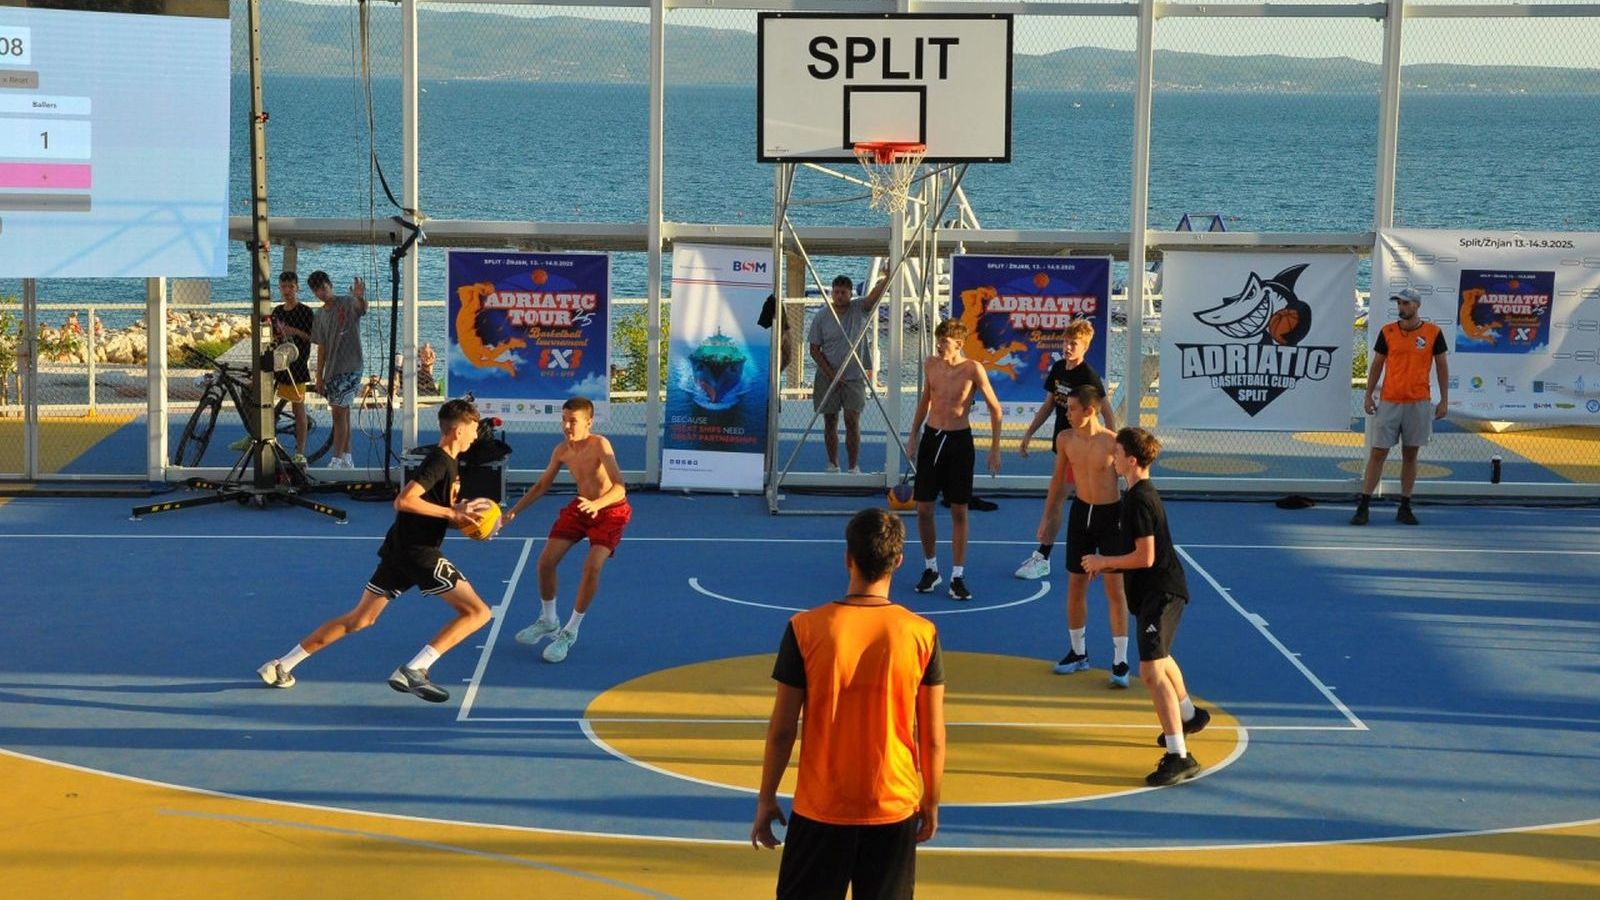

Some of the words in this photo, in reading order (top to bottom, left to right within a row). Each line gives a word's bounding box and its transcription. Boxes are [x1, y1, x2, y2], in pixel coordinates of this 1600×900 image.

[807, 36, 960, 80] SPLIT
[32, 101, 58, 109] Ballers
[39, 131, 49, 149] 1
[1459, 237, 1513, 249] Split/Žnjan
[1514, 238, 1576, 249] 13.-14.9.2025.
[484, 292, 596, 309] ADRIATIC
[987, 296, 1097, 313] ADRIATIC
[1478, 294, 1549, 305] ADRIATIC
[1492, 305, 1532, 314] TOUR
[509, 310, 572, 325] TOUR
[572, 308, 597, 327] 25
[1010, 313, 1071, 329] TOUR
[528, 327, 582, 339] Basketball
[1181, 343, 1332, 381] ADRIATIC
[1211, 375, 1270, 388] BASKETBALL
[1270, 375, 1297, 389] CLUB
[1238, 389, 1268, 402] SPLIT
[671, 415, 708, 424] BECAUSE
[722, 426, 745, 435] NEED
